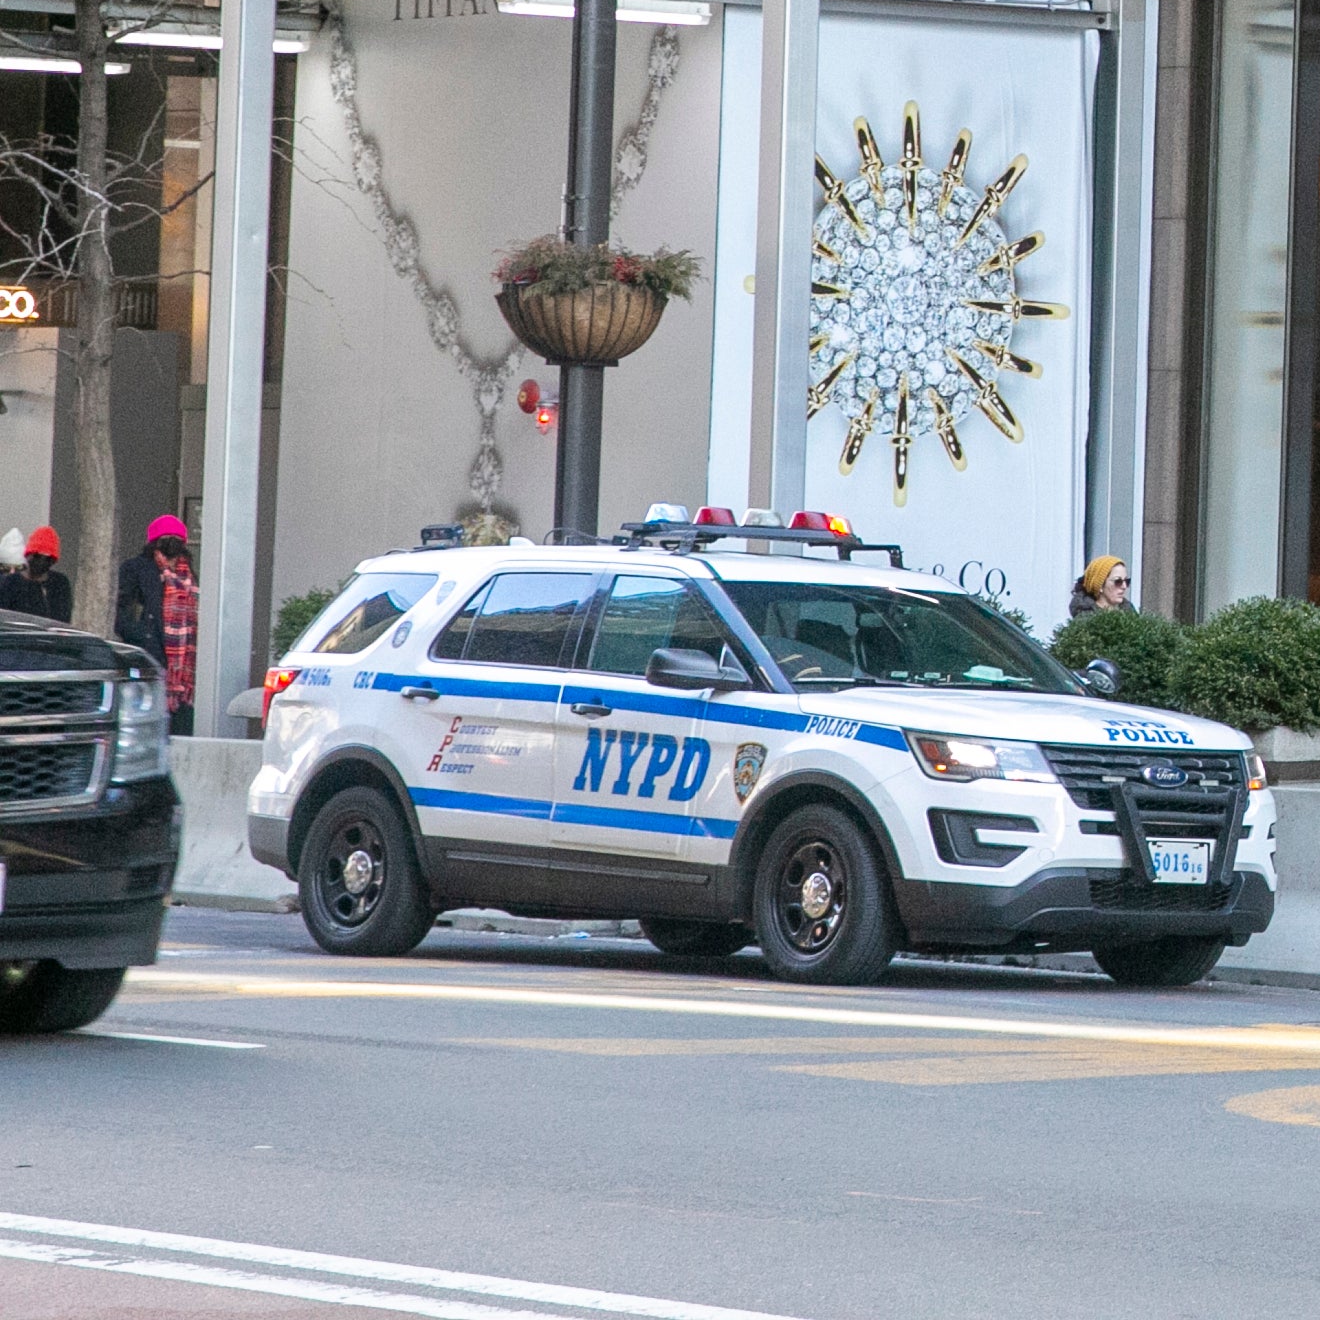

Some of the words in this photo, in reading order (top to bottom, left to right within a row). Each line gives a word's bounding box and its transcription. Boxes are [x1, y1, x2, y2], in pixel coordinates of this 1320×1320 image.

[806, 714, 861, 740] POLICE
[1103, 727, 1195, 745] POLICE
[426, 754, 475, 774] RESPECT
[572, 727, 711, 802] NYPD
[1156, 767, 1180, 780] Ford
[1153, 852, 1189, 873] 5016
[1191, 863, 1203, 874] 16
